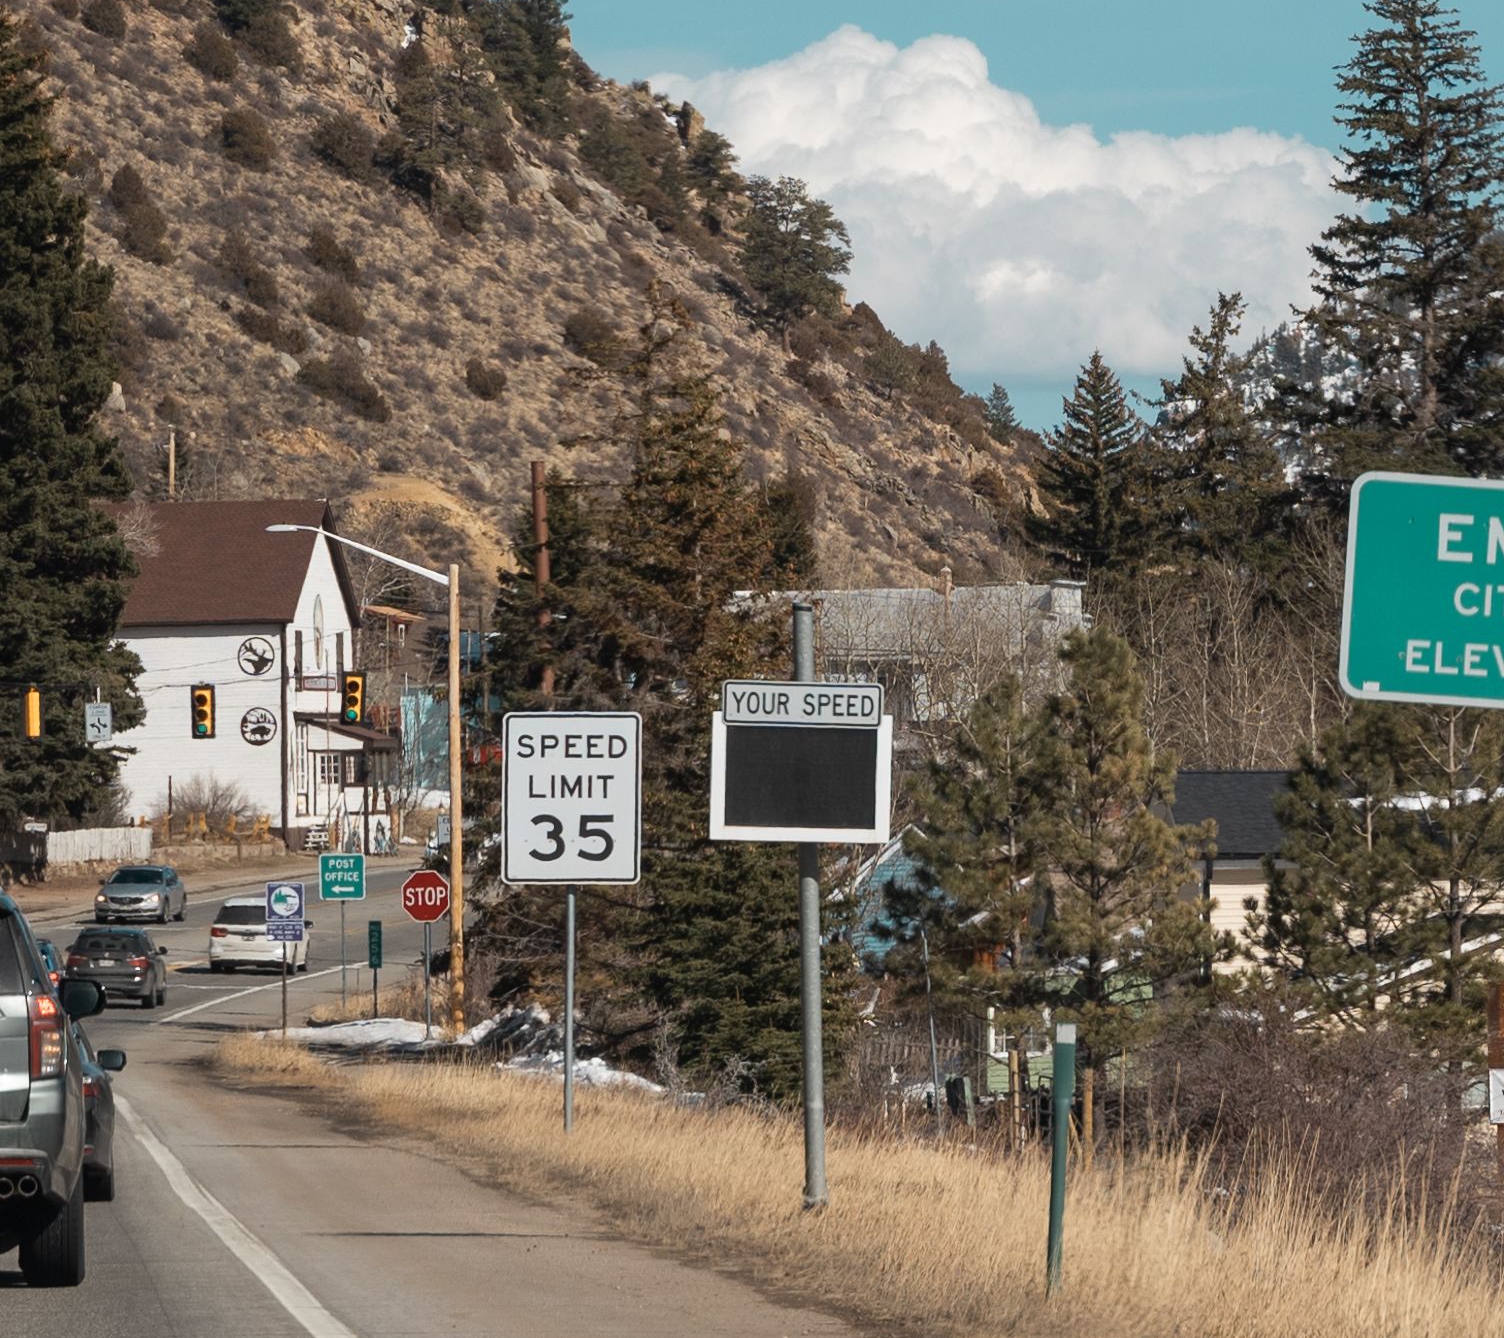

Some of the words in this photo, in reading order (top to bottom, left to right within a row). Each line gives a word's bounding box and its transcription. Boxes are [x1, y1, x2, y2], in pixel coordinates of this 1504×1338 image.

[732, 691, 789, 715] YOUR
[802, 693, 874, 717] SPEED
[517, 734, 627, 759] SPEED
[528, 774, 614, 799] LIMIT
[528, 814, 614, 862] 35
[325, 871, 359, 882] OFFICE
[328, 859, 354, 869] POST
[405, 887, 446, 906] STOP
